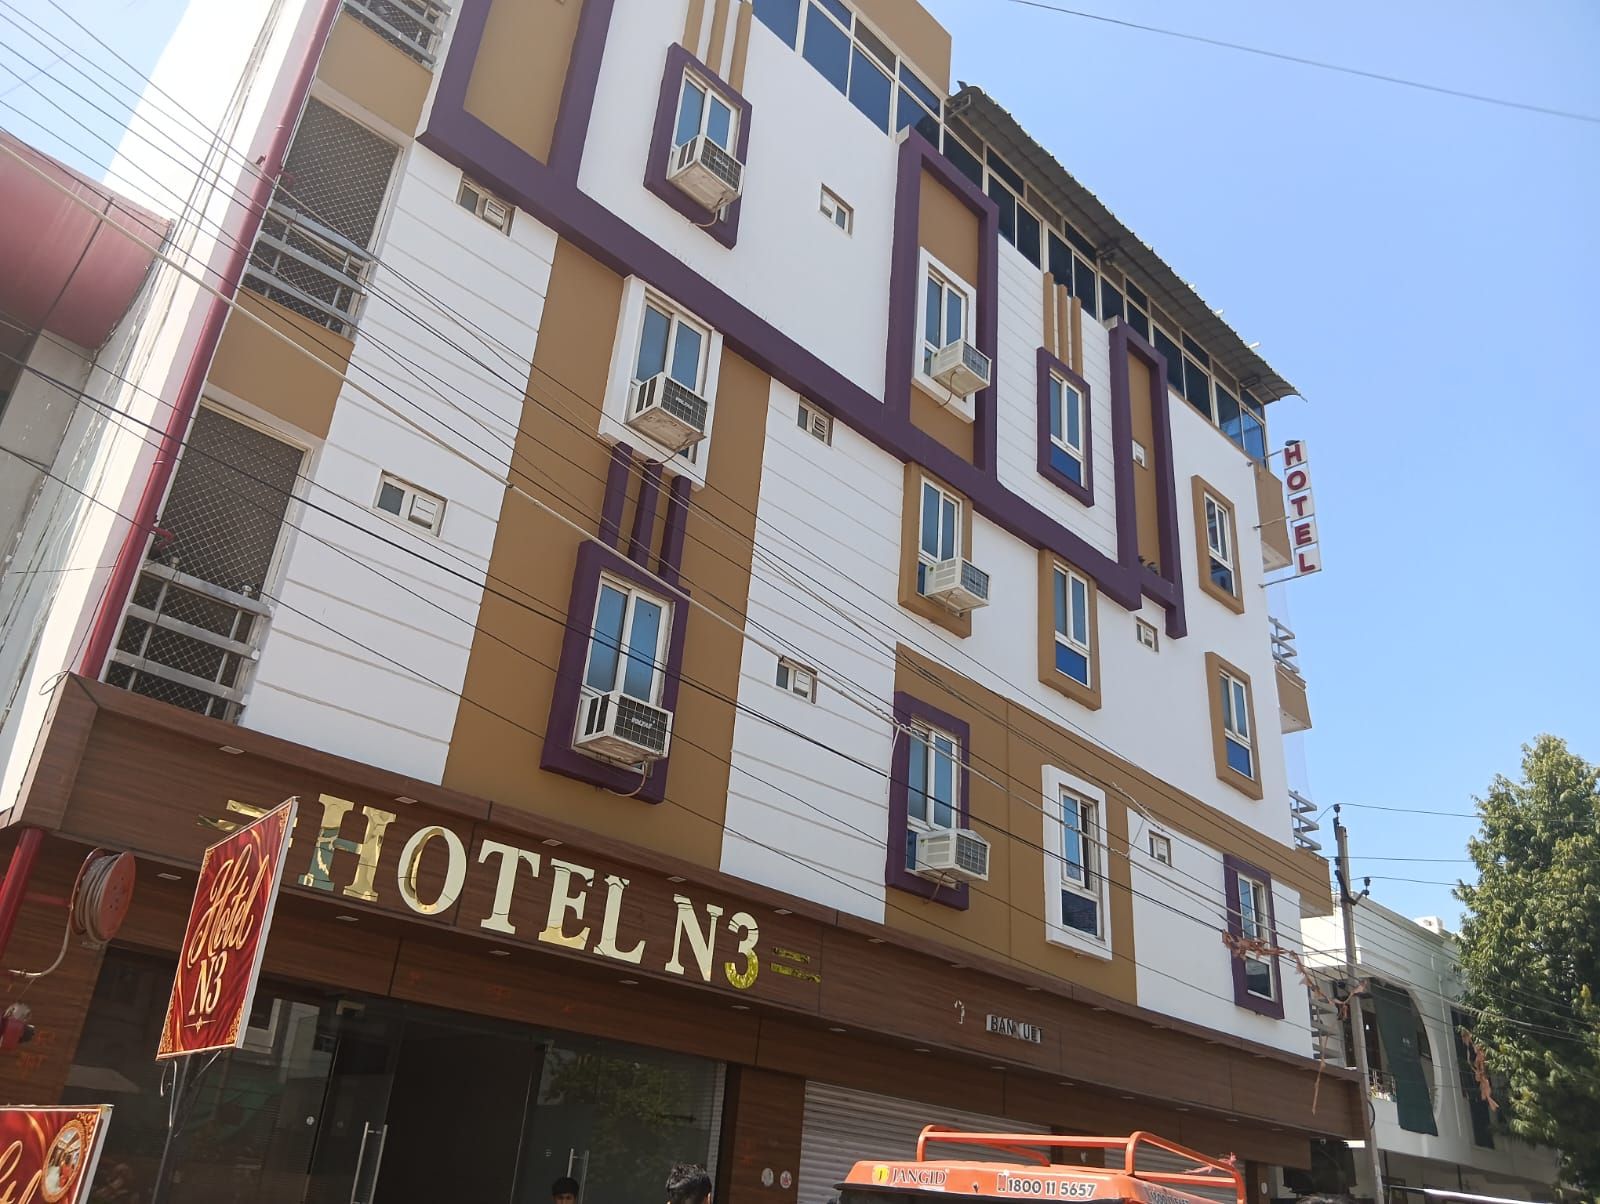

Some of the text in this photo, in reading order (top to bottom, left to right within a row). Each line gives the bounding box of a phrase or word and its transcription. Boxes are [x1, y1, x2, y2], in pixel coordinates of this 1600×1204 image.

[1284, 444, 1315, 573] HOTEL
[187, 843, 270, 969] Hotel
[298, 793, 760, 990] HOTEL N3
[188, 951, 229, 1016] N3
[892, 1167, 947, 1186] JANGID
[1008, 1178, 1097, 1198] 1800 11 5657
